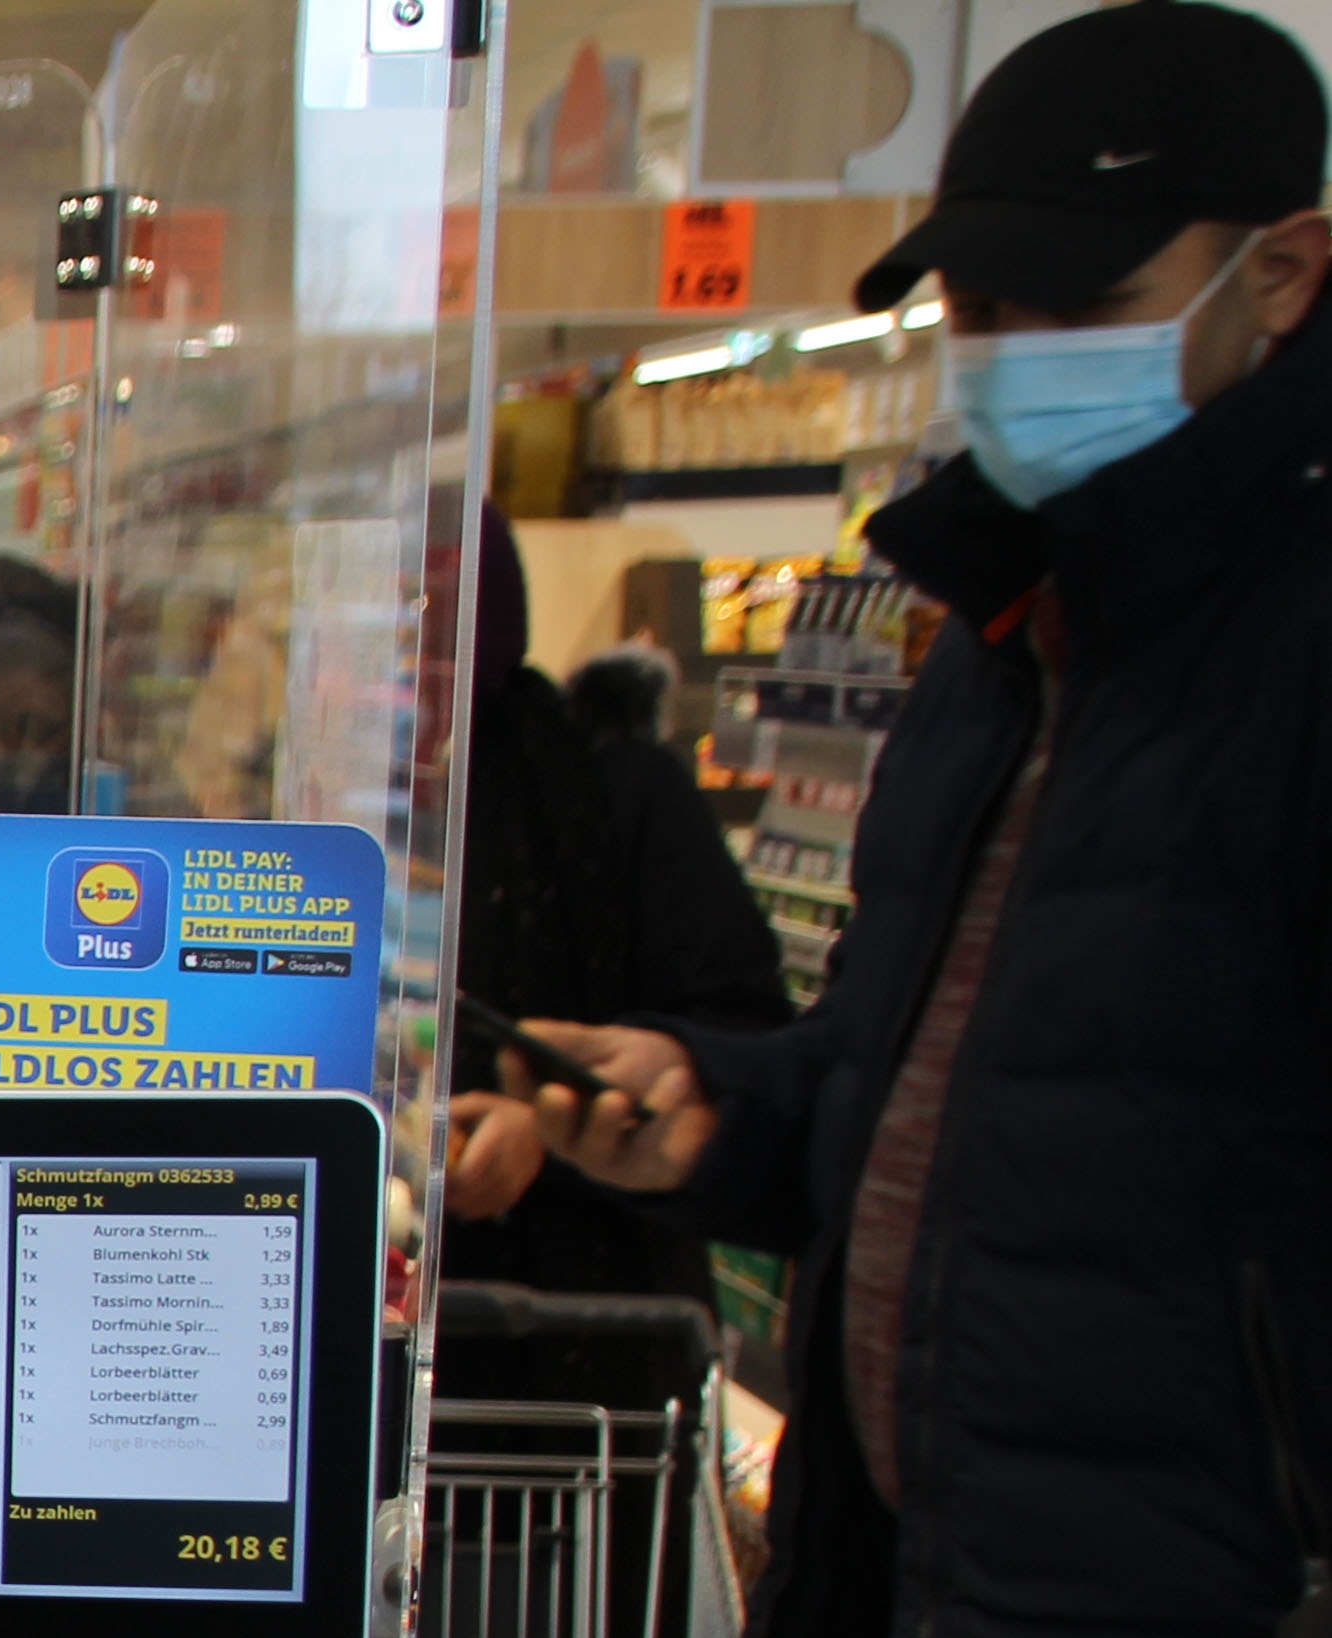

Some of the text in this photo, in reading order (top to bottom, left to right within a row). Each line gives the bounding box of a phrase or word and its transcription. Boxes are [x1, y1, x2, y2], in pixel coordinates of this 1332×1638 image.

[184, 849, 292, 870] LIDL PAY:
[183, 872, 304, 892] IN DEINER
[181, 894, 351, 916] LIDL PLUS APP
[185, 921, 349, 943] Jetzt runterladen!
[77, 933, 132, 961] Plus
[200, 957, 253, 971] App Store
[287, 960, 347, 975] Google Play
[49, 1003, 156, 1038] PLUS
[135, 1058, 304, 1090] ZAHLEN
[16, 1167, 235, 1188] Schmutzfangm 0362533
[16, 1191, 104, 1212] Menge 1x
[286, 1194, 299, 1210] €
[22, 1224, 39, 1237] 1x
[93, 1224, 145, 1238] Aurora
[263, 1225, 292, 1241] 1,59
[22, 1248, 292, 1264] 1x Blumenkohl Stk 1,29
[21, 1271, 291, 1288] 1x Tassimo Latte 3,33
[20, 1295, 37, 1308] 1x
[91, 1295, 153, 1309] Tassimo
[260, 1297, 291, 1312] 3,33
[20, 1319, 37, 1331] 1x
[91, 1318, 173, 1333] Dorfmühle
[260, 1321, 290, 1336] 1,89
[19, 1342, 36, 1354] 1x
[258, 1344, 289, 1359] 3,49
[19, 1366, 288, 1383] 1x Lorbeerblätter 0,69
[18, 1389, 288, 1406] 1x Lorbeerblätter 0,69
[18, 1412, 287, 1430] 1x Schmutzfangm 2,99
[8, 1503, 98, 1521] Zu zahlen
[177, 1534, 289, 1563] 20,18 €
